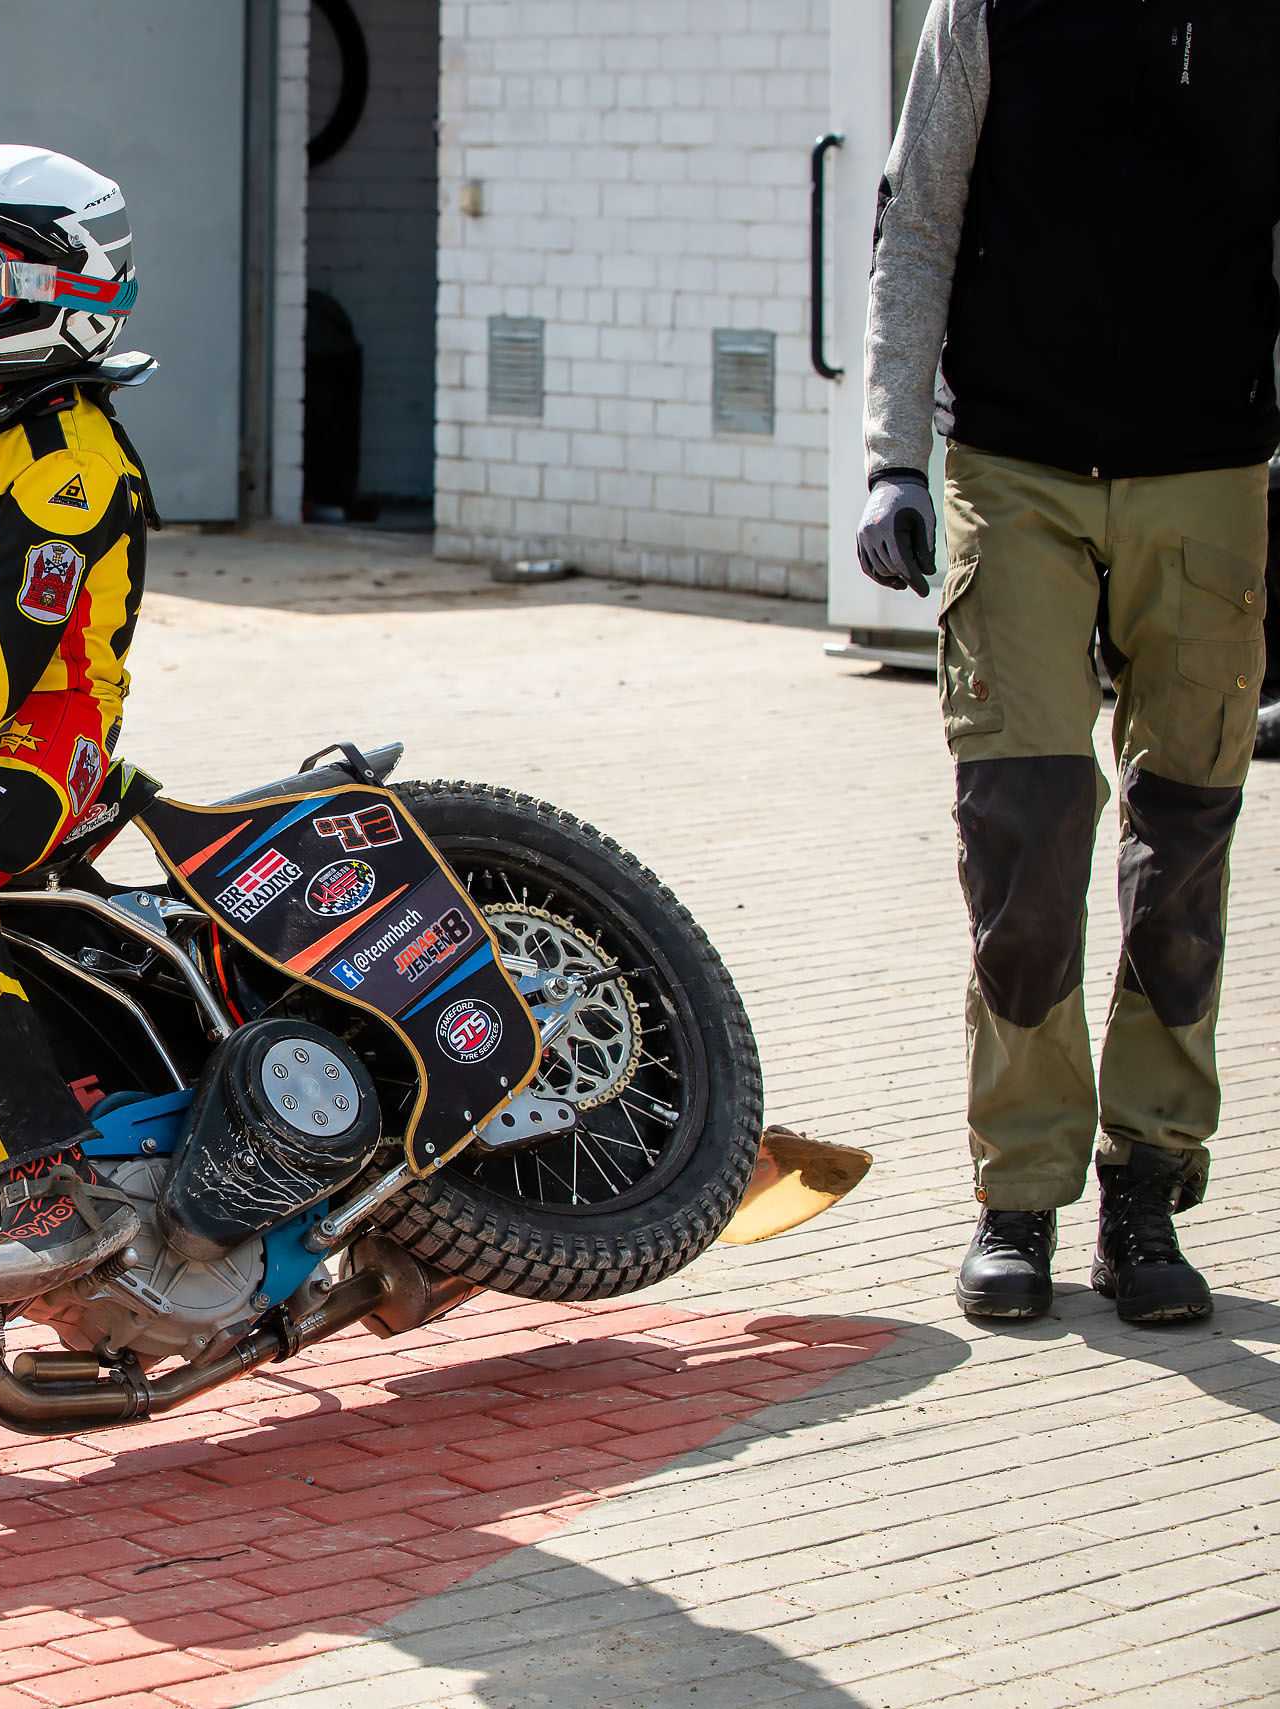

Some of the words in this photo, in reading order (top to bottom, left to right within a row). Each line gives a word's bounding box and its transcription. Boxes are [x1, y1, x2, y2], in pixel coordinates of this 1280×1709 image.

[1184, 22, 1192, 71] MULTIFUNCTION
[215, 886, 246, 911] BR
[231, 863, 302, 922] TRADING
[353, 908, 423, 973] @teambach
[394, 928, 438, 974] JONAS
[409, 932, 453, 981] JENSEN
[439, 1001, 474, 1038] STAKEFORD
[450, 1010, 487, 1051] STS
[460, 1051, 479, 1061] TYRE
[478, 1022, 499, 1056] SERVICES
